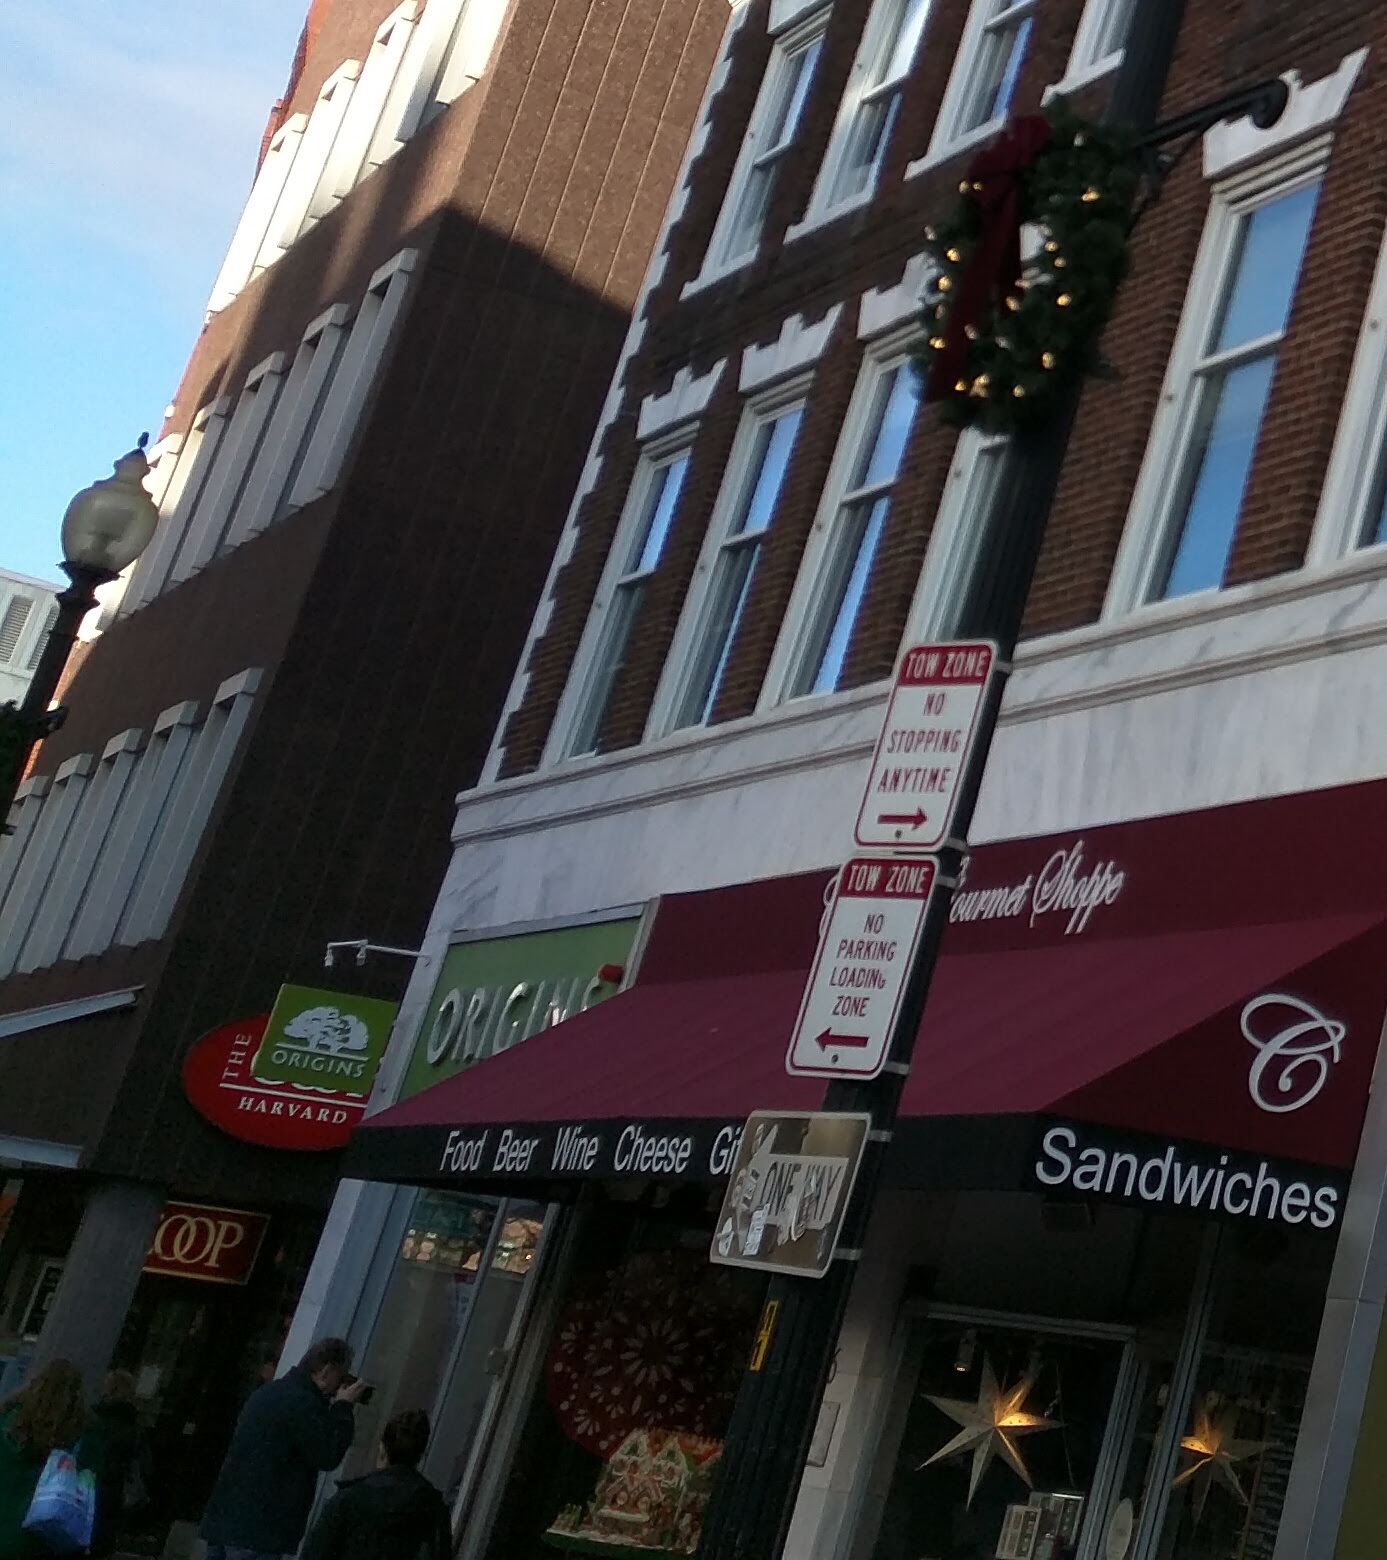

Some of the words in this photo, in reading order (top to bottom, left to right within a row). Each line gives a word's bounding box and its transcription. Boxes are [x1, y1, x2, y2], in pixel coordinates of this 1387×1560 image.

[905, 651, 940, 679] TOW
[941, 649, 991, 678] ZONE
[922, 691, 946, 716] NO
[887, 729, 962, 754] STOPPING
[877, 767, 952, 793] ANYTIME
[846, 864, 882, 892] TOW
[884, 865, 930, 894] ZONE
[946, 873, 1035, 924] ourmet
[1028, 839, 1126, 935] Shoppe
[863, 913, 885, 934] NO
[836, 938, 897, 962] PARKING
[828, 966, 886, 990] LOADING
[831, 995, 871, 1018] ZONE
[221, 1032, 252, 1080] THE
[270, 1049, 367, 1079] ORIGINS
[237, 1095, 349, 1125] HARVARD
[438, 1128, 489, 1172] Food
[492, 1128, 543, 1172] Beer
[550, 1124, 600, 1172] Wine
[613, 1123, 694, 1174] Cheese
[1034, 1126, 1339, 1229] Sandwiches
[148, 1213, 245, 1268] OOP
